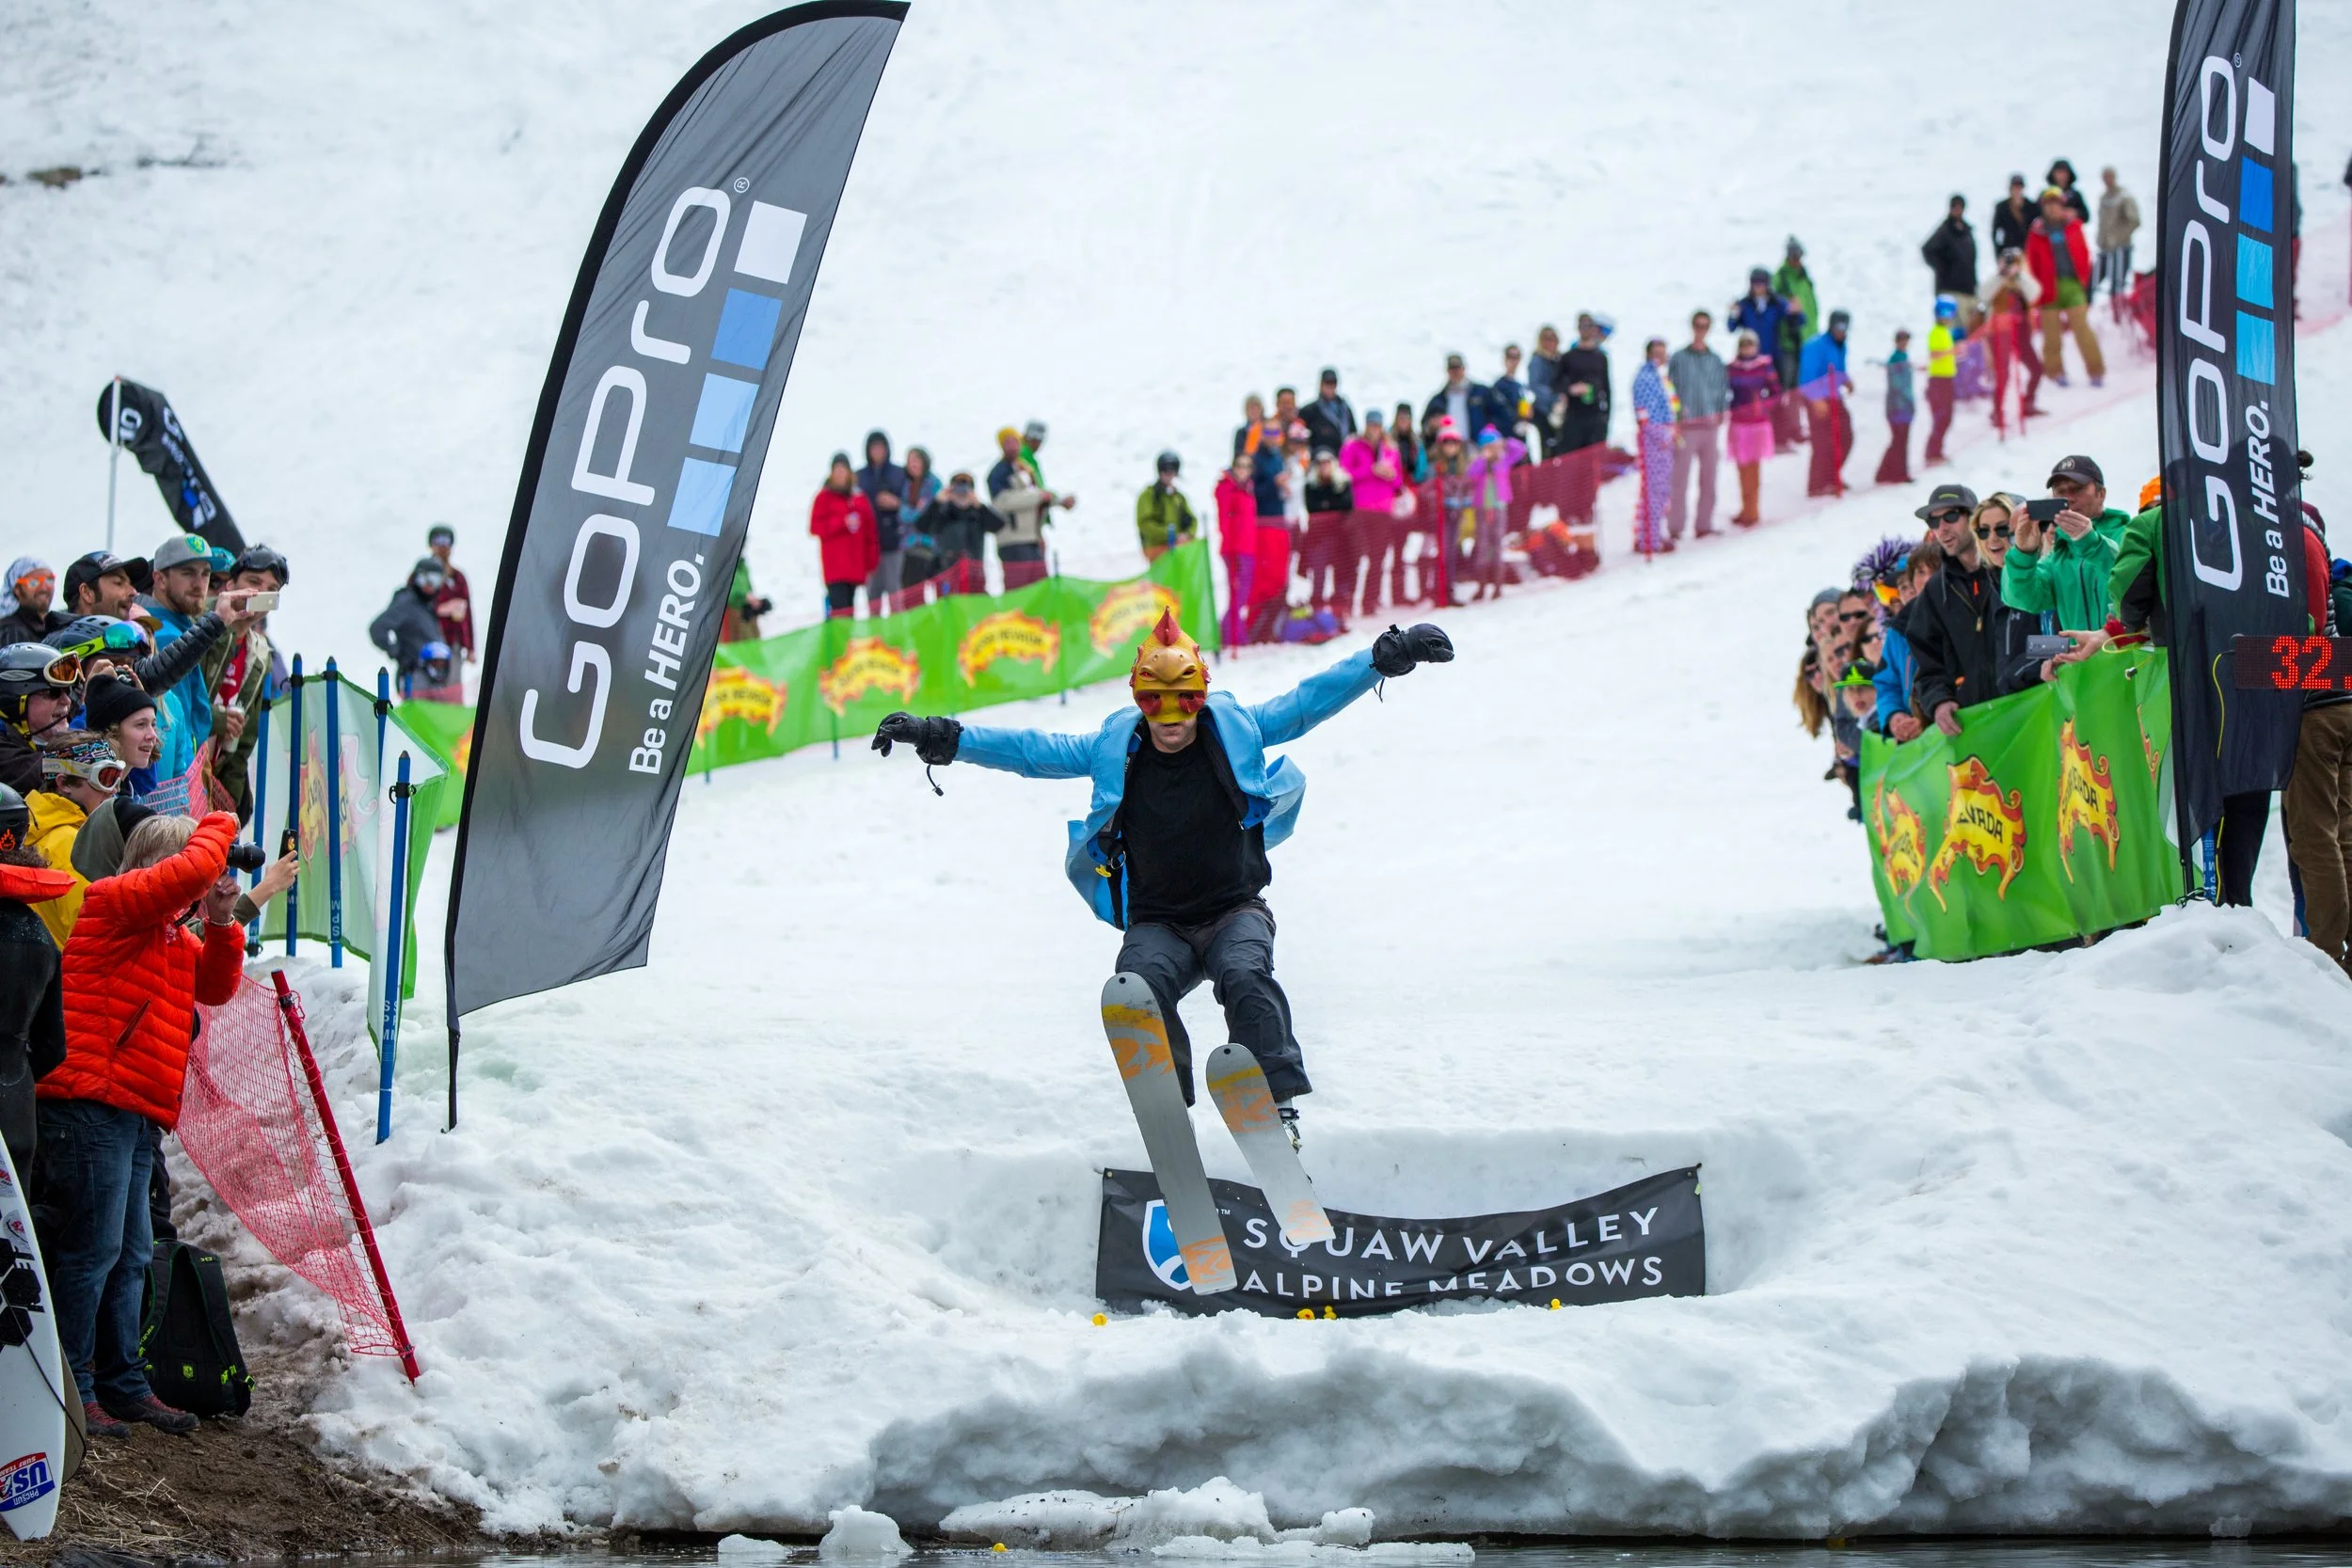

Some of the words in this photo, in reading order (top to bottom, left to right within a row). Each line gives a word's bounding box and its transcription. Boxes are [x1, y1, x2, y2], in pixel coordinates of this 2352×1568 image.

[2245, 400, 2280, 525] HERO.
[2265, 529, 2283, 549] a
[2265, 555, 2290, 598] Be
[644, 552, 705, 691] HERO.
[649, 698, 674, 721] a
[628, 727, 667, 775] Be
[1463, 1207, 1658, 1265] VALLEY
[1242, 1269, 1404, 1300] ALPINE
[1429, 1257, 1663, 1292] MEADOWS
